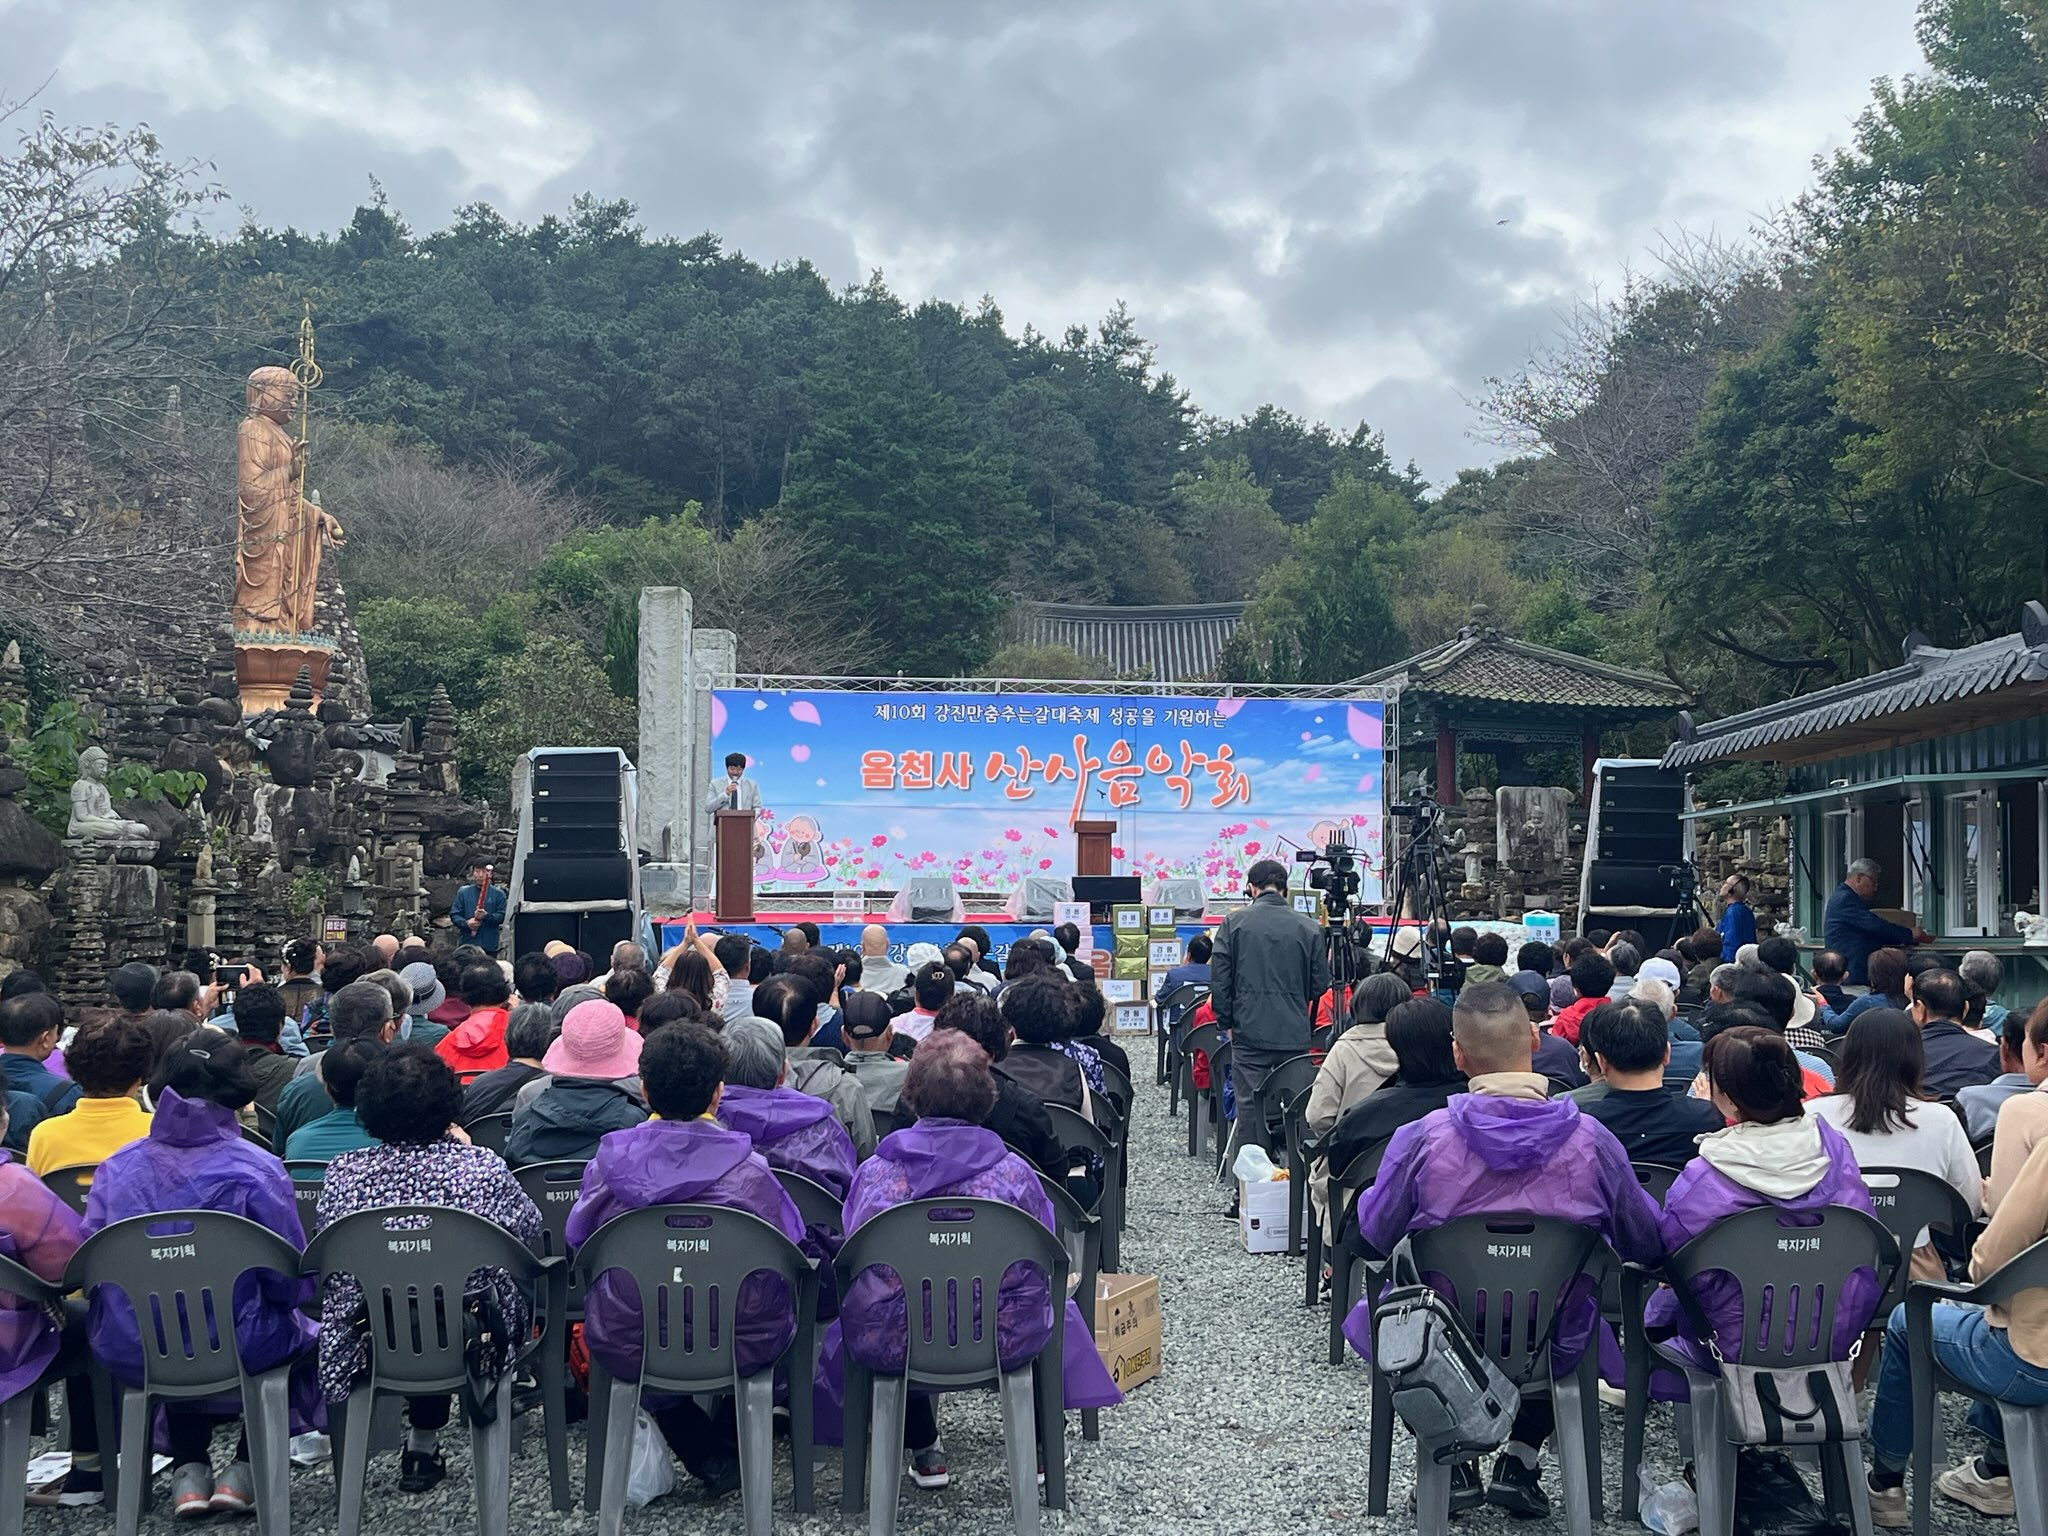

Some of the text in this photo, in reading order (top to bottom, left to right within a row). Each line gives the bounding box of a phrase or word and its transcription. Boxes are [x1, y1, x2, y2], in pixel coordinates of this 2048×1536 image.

[873, 704, 1228, 728] 제10회 강진만춤추는갈대축제 성공을 기원하는
[862, 750, 973, 790] 옴천사
[295, 1190, 325, 1201] 복지기
[388, 1239, 431, 1254] 복지기획
[667, 1239, 710, 1253] 복지기획
[929, 1232, 971, 1246] 복지기획
[1777, 1237, 1820, 1252] 복지기획
[151, 1244, 196, 1260] 복지기획
[1487, 1244, 1531, 1258] 복지기획
